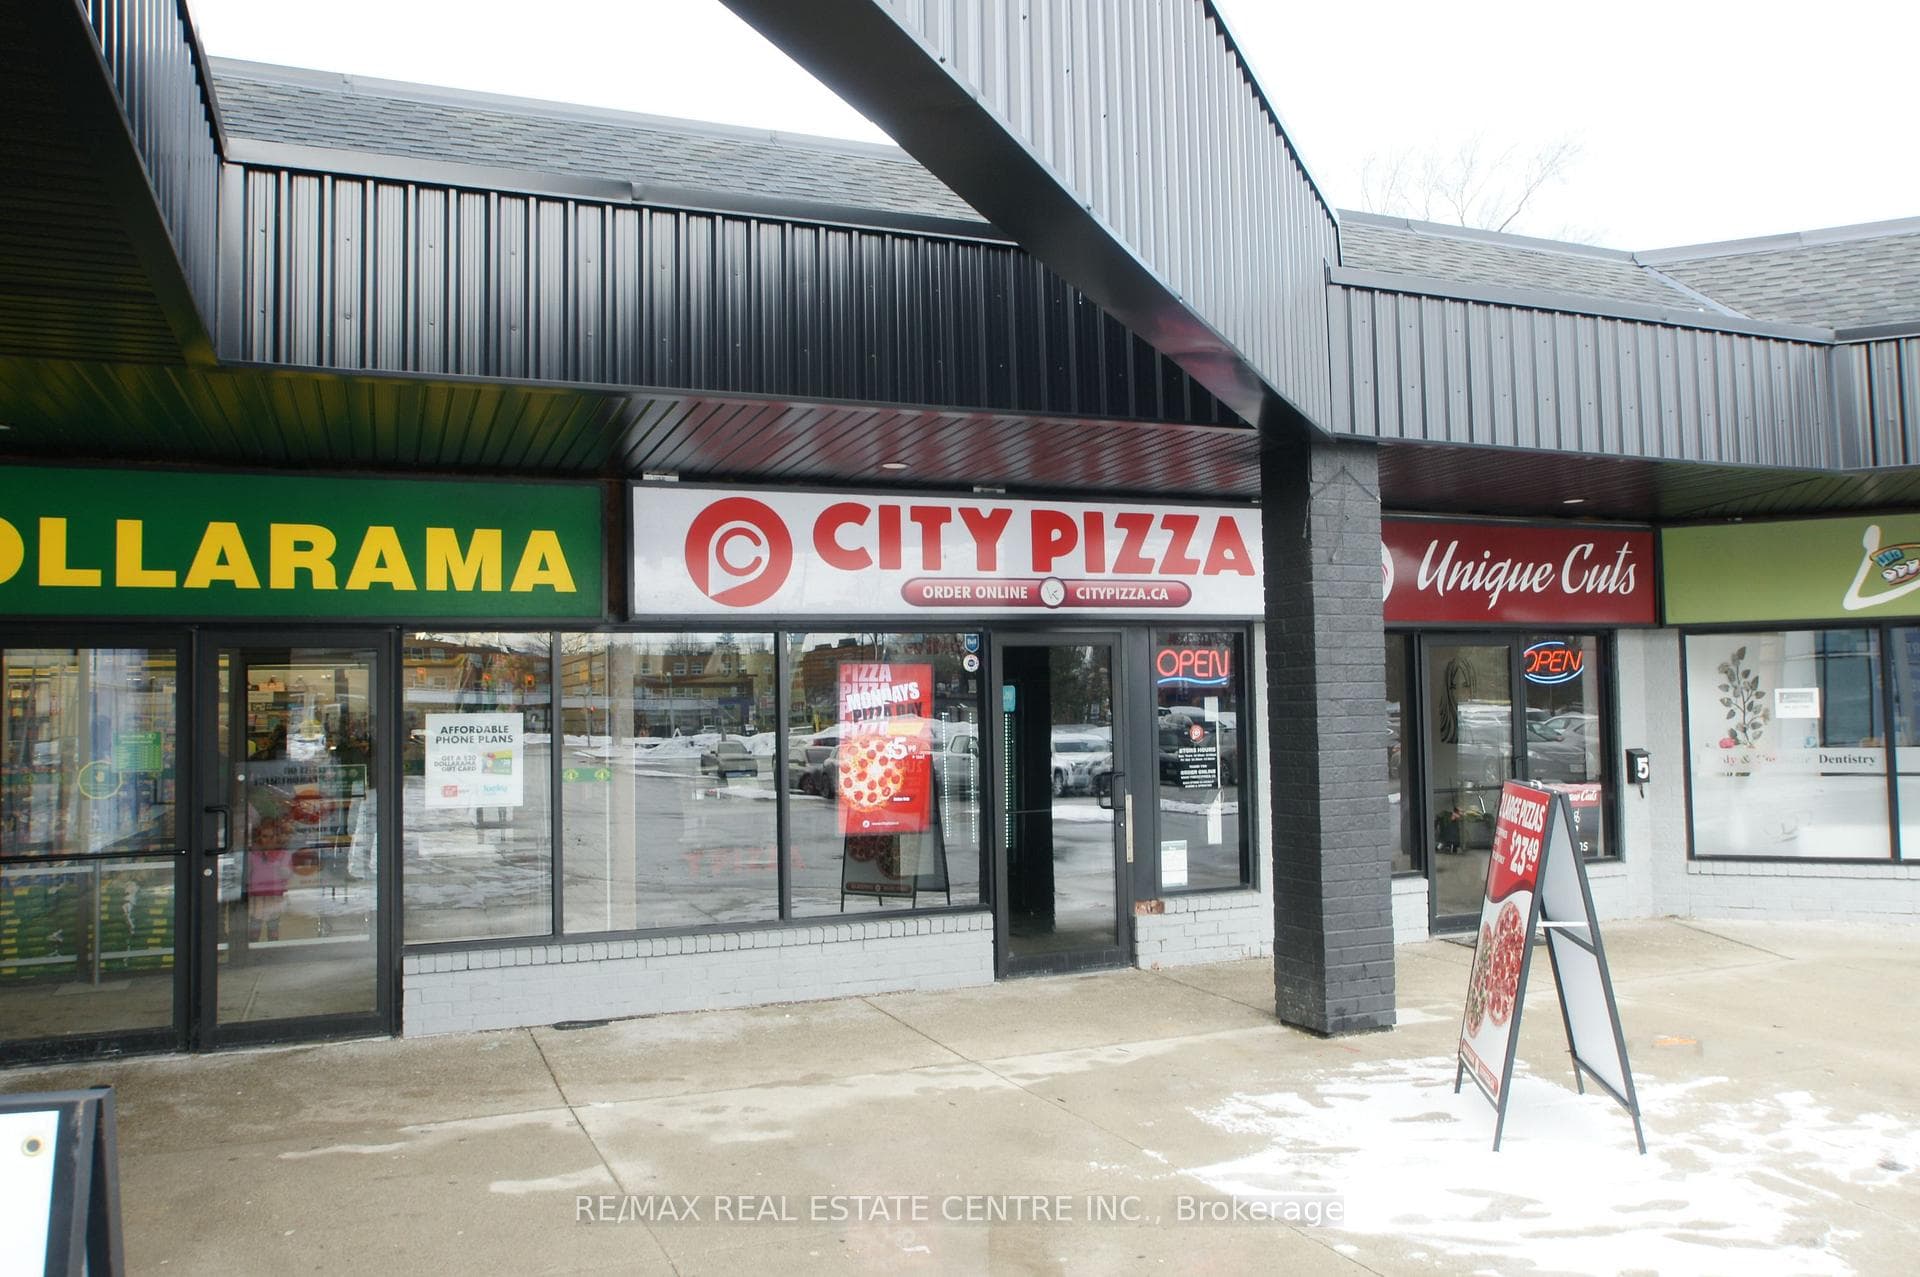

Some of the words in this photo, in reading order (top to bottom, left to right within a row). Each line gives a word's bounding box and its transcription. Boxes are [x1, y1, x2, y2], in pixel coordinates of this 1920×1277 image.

[812, 502, 1013, 572] CITY
[1031, 509, 1256, 577] PIZZA
[1417, 539, 1555, 610] Unique
[1561, 541, 1637, 595] Cuts
[922, 584, 972, 600] ORDER
[975, 585, 1028, 600] ONLINE
[1076, 587, 1169, 602] CITYPIZZA.CA
[840, 663, 892, 683] PIZZA
[1156, 648, 1230, 678] OPEN
[846, 681, 920, 713] MONDAYS
[435, 735, 475, 745] PHONE
[478, 734, 514, 744] PLANS
[440, 725, 509, 734] AFFORDABLE
[1637, 756, 1650, 779] 5
[1818, 753, 1877, 764] Dentistry
[1518, 799, 1547, 834] PIZZAS
